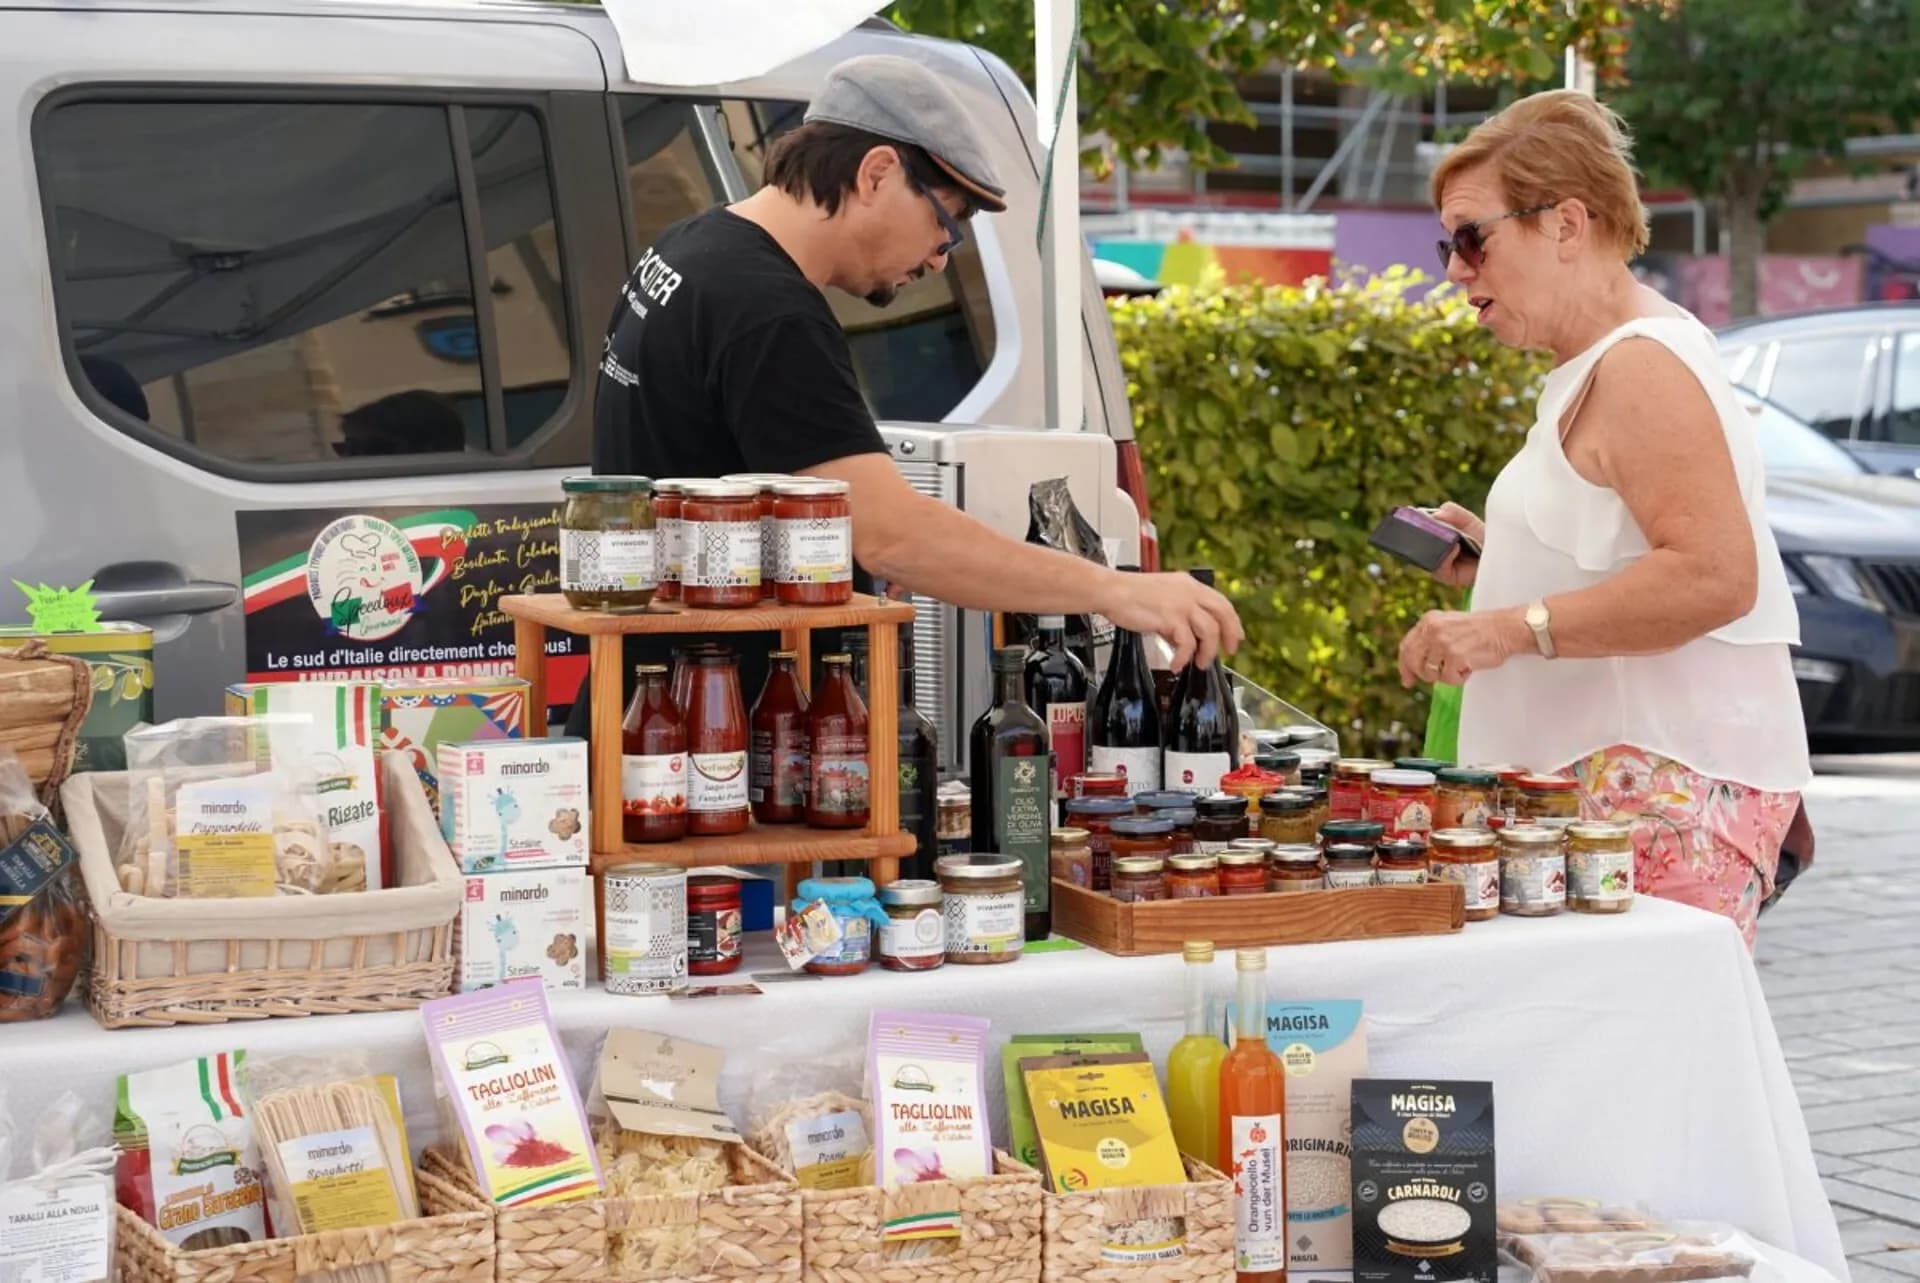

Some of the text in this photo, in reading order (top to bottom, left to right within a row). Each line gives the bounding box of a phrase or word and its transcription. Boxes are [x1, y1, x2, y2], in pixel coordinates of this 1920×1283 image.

[267, 652, 288, 668] Le
[293, 651, 325, 667] sud
[329, 648, 384, 665] d'Italie
[388, 642, 485, 663] directement
[501, 757, 550, 775] minardo
[201, 800, 247, 814] minardo
[329, 800, 375, 827] Rigate
[500, 883, 549, 901] minardo
[1267, 1014, 1329, 1032] MAGISA
[467, 1063, 556, 1101] TAGLIOLINI
[890, 1103, 973, 1120] TAGLIOLINI
[1060, 1097, 1135, 1120] MAGISA
[1391, 1094, 1456, 1113] MAGISA
[807, 1124, 845, 1144] minardo
[307, 1140, 353, 1160] minardo
[307, 1160, 364, 1180] Spaghetti
[1260, 1148, 1272, 1184] Musel
[1387, 1183, 1461, 1202] CARNAROLI
[8, 1213, 44, 1224] TARALLI
[46, 1208, 68, 1219] ALLA
[1290, 1253, 1318, 1262] MAGISA
